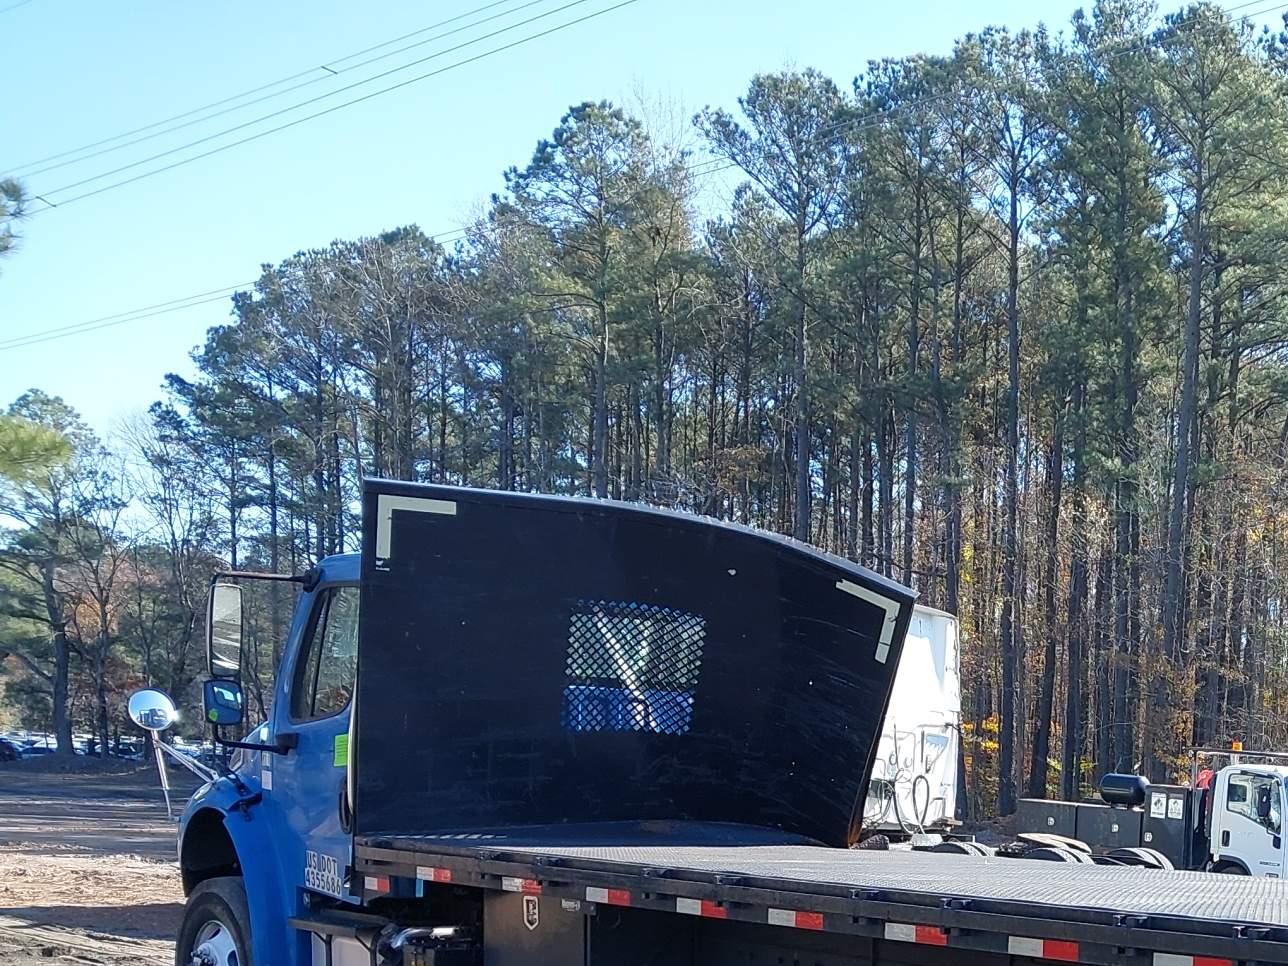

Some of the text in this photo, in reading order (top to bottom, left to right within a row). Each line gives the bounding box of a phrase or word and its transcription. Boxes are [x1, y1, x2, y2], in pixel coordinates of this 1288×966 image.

[307, 852, 337, 876] US DOT
[305, 869, 341, 895] 4355686
